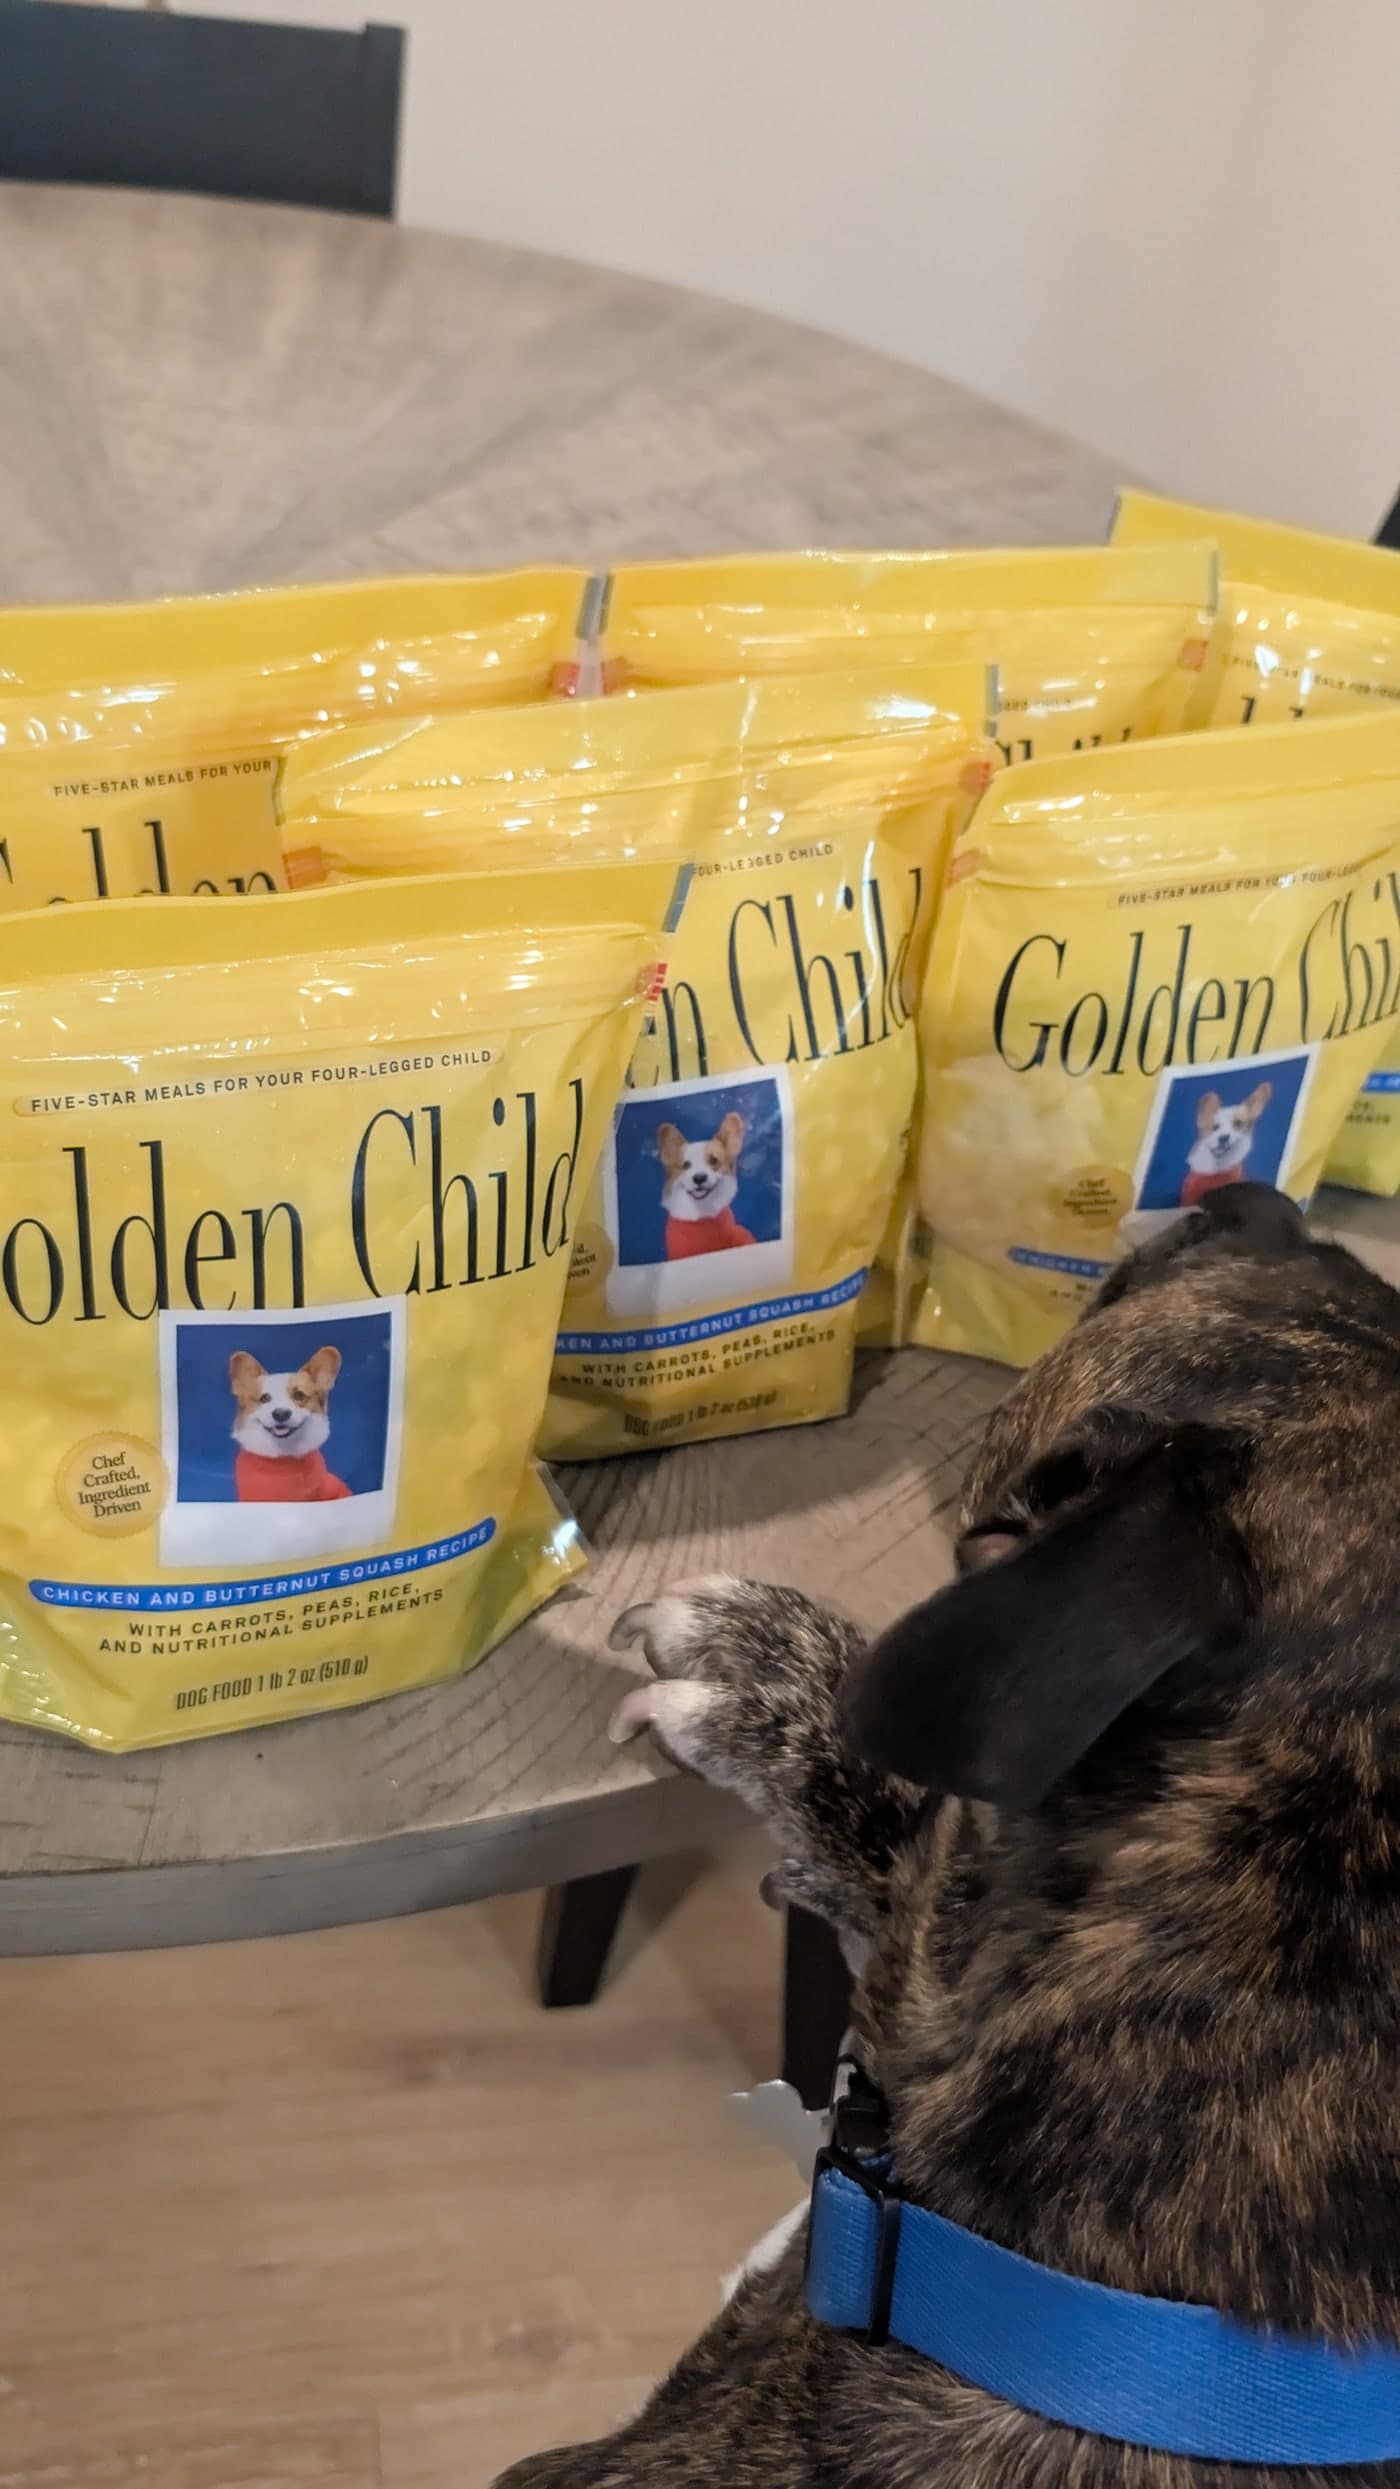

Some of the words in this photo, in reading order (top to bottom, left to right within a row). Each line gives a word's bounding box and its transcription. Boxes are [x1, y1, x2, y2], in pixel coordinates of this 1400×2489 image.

[54, 778, 139, 797] FIVE-STAR
[145, 770, 194, 788] MEALS
[201, 767, 228, 780] FOR
[233, 760, 272, 774] YOUR
[728, 867, 922, 1066] Child
[993, 924, 1275, 1078] Golden
[32, 1094, 136, 1112] FIVE-STAR
[145, 1083, 206, 1102] MEALS
[214, 1077, 248, 1093] FOR
[256, 1072, 304, 1088] YOUR
[312, 1057, 434, 1082] FOUR-LEGGED
[442, 1050, 492, 1068] CHILD
[352, 1078, 583, 1300] Child
[601, 1336, 636, 1349] AND
[644, 1314, 743, 1345] BUTTERNUT
[749, 1297, 815, 1320] SQUASH
[602, 1364, 715, 1388] NUTRITIONAL
[723, 1329, 835, 1369] SUPPLEMENTS
[83, 1466, 141, 1488] Crafted,
[92, 1451, 127, 1471] Chef
[77, 1480, 151, 1506] Ingredient
[94, 1500, 142, 1518] Driven
[43, 1586, 140, 1606] CHICKEN
[150, 1591, 195, 1606] AND
[205, 1573, 331, 1602] BUTTERNUT
[339, 1554, 418, 1582] SQUASH
[427, 1526, 488, 1562] RECIPE
[99, 1638, 142, 1655] AND
[152, 1624, 293, 1655] NUTRITIONAL
[302, 1588, 444, 1631] SUPPLEMENTS
[129, 1621, 182, 1638] WITH
[192, 1609, 294, 1635] CARROTS,
[303, 1597, 360, 1617] PEAS,
[369, 1583, 420, 1602] RICE,
[176, 1688, 207, 1711] DOG
[212, 1677, 252, 1702] FOOD
[258, 1675, 264, 1693] 1
[270, 1671, 282, 1691] lb
[288, 1668, 297, 1687] 2
[300, 1666, 316, 1686] oz
